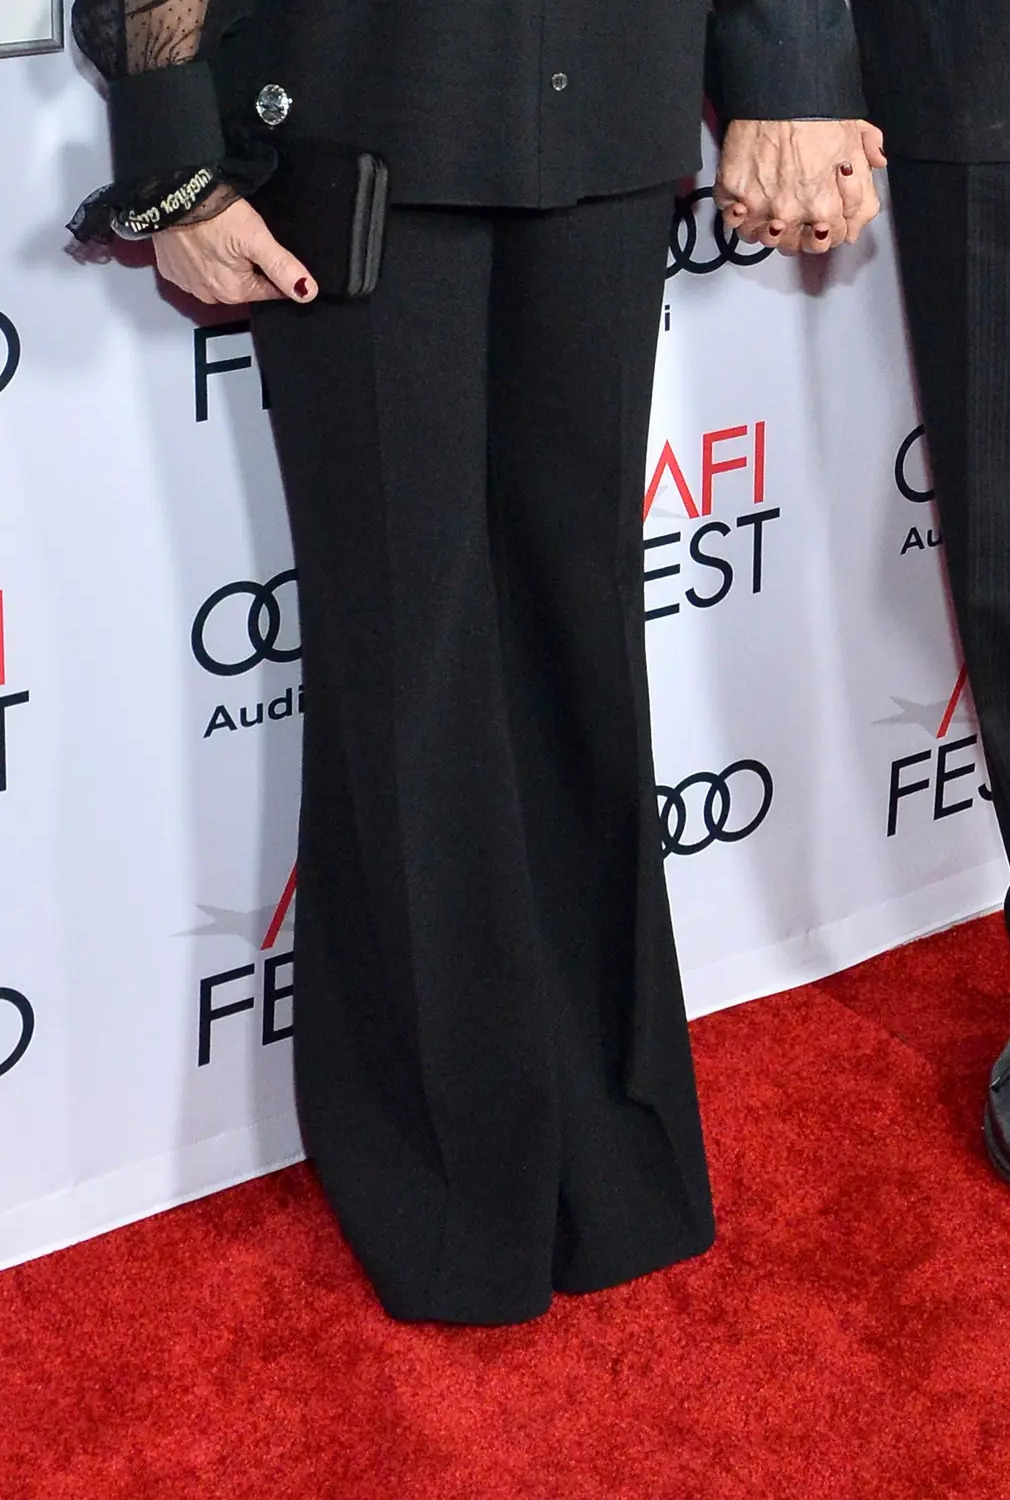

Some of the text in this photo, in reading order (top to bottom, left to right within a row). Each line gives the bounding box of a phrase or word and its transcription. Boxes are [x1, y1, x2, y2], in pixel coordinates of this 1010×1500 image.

[643, 421, 765, 525] AFI
[643, 507, 780, 622] EST
[203, 684, 304, 738] Audi
